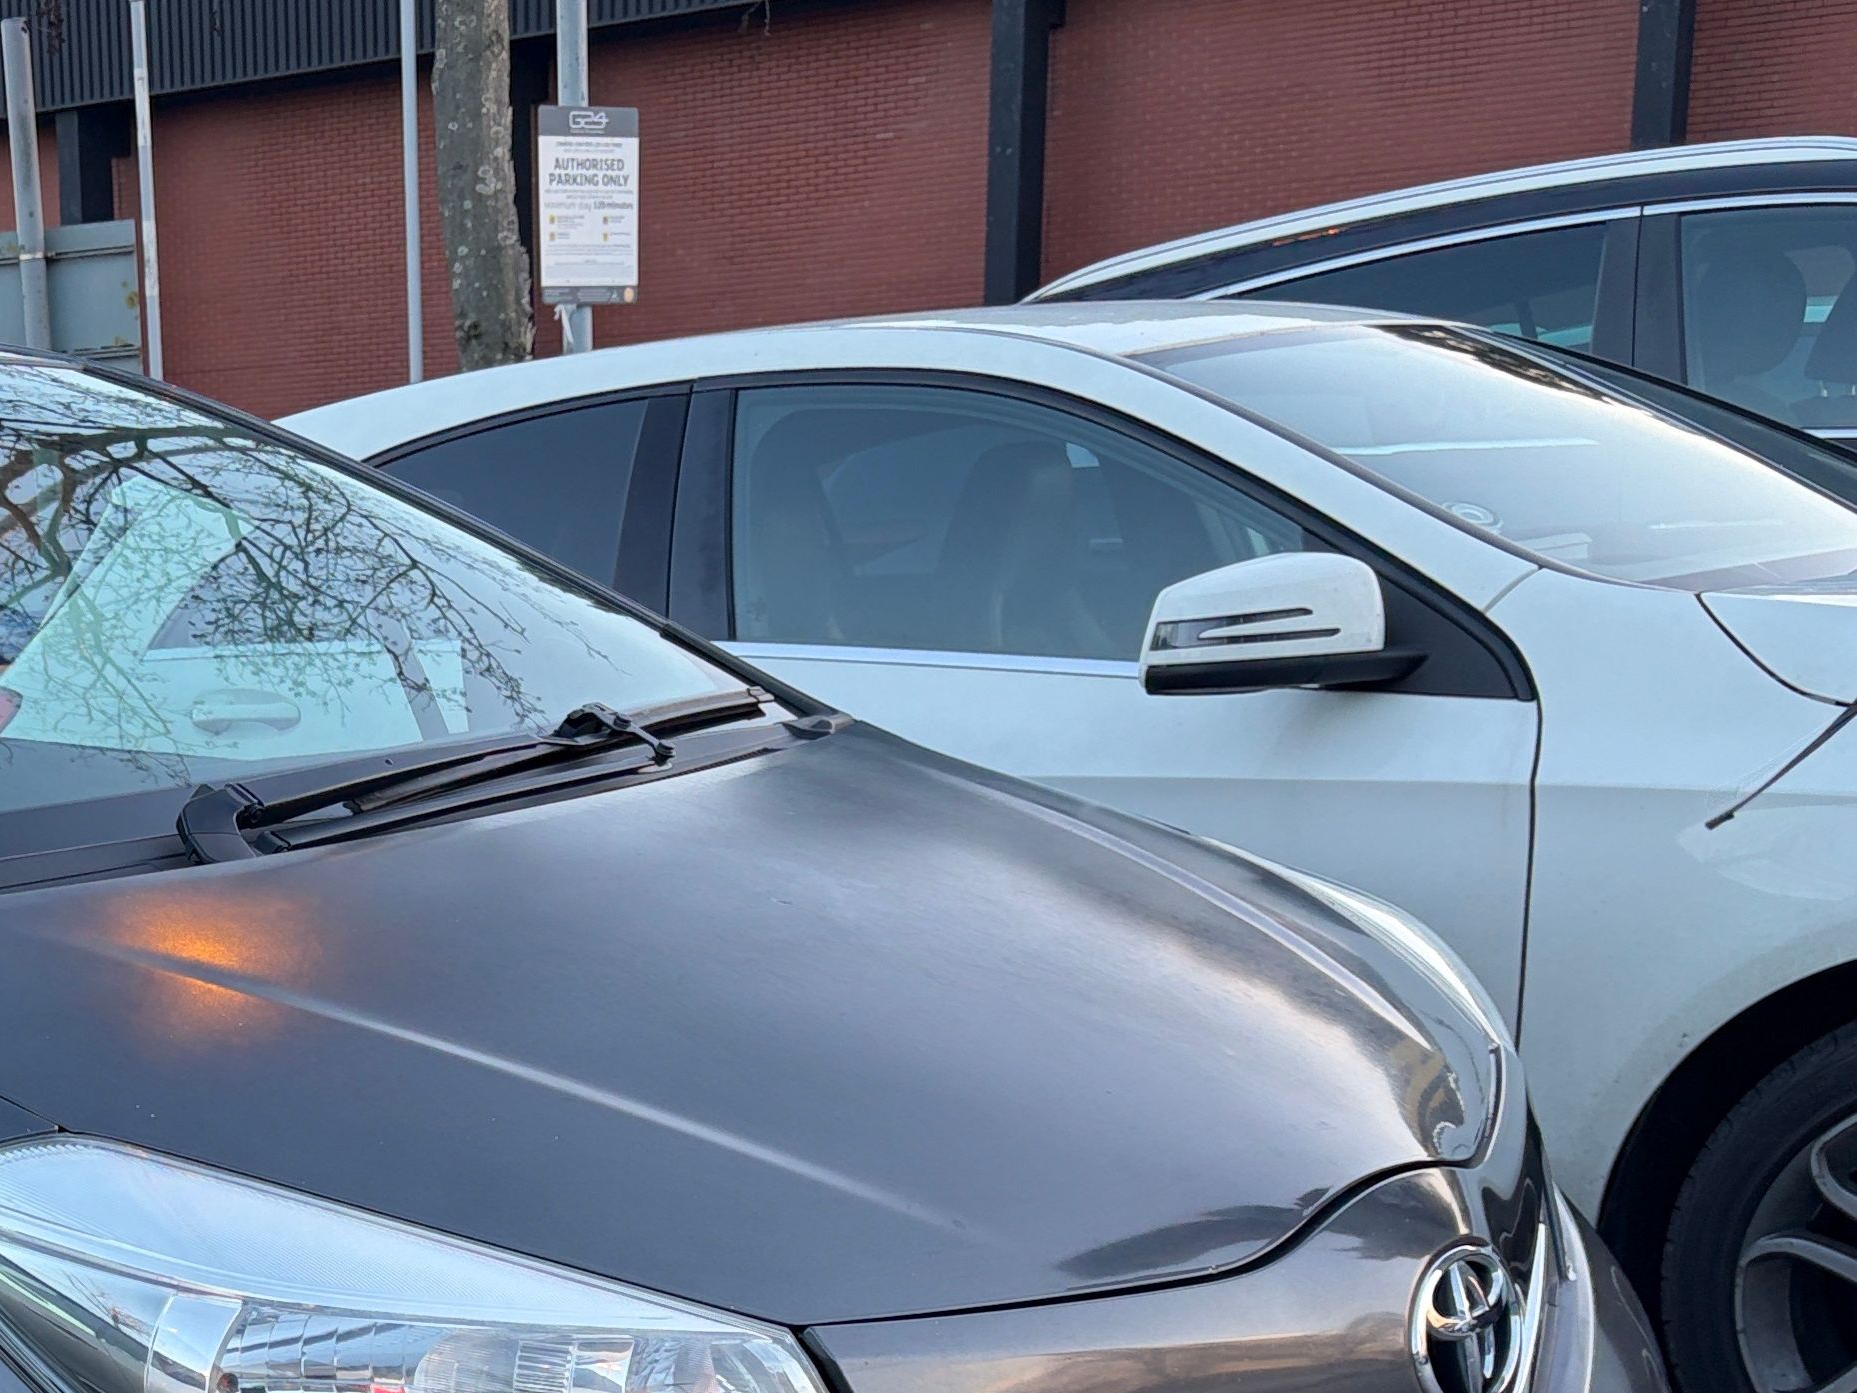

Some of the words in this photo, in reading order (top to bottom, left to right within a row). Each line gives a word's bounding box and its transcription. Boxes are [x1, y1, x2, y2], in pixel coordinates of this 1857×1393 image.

[554, 157, 625, 171] AUTHORISED
[548, 172, 600, 187] PARKING
[601, 173, 630, 187] ONLY
